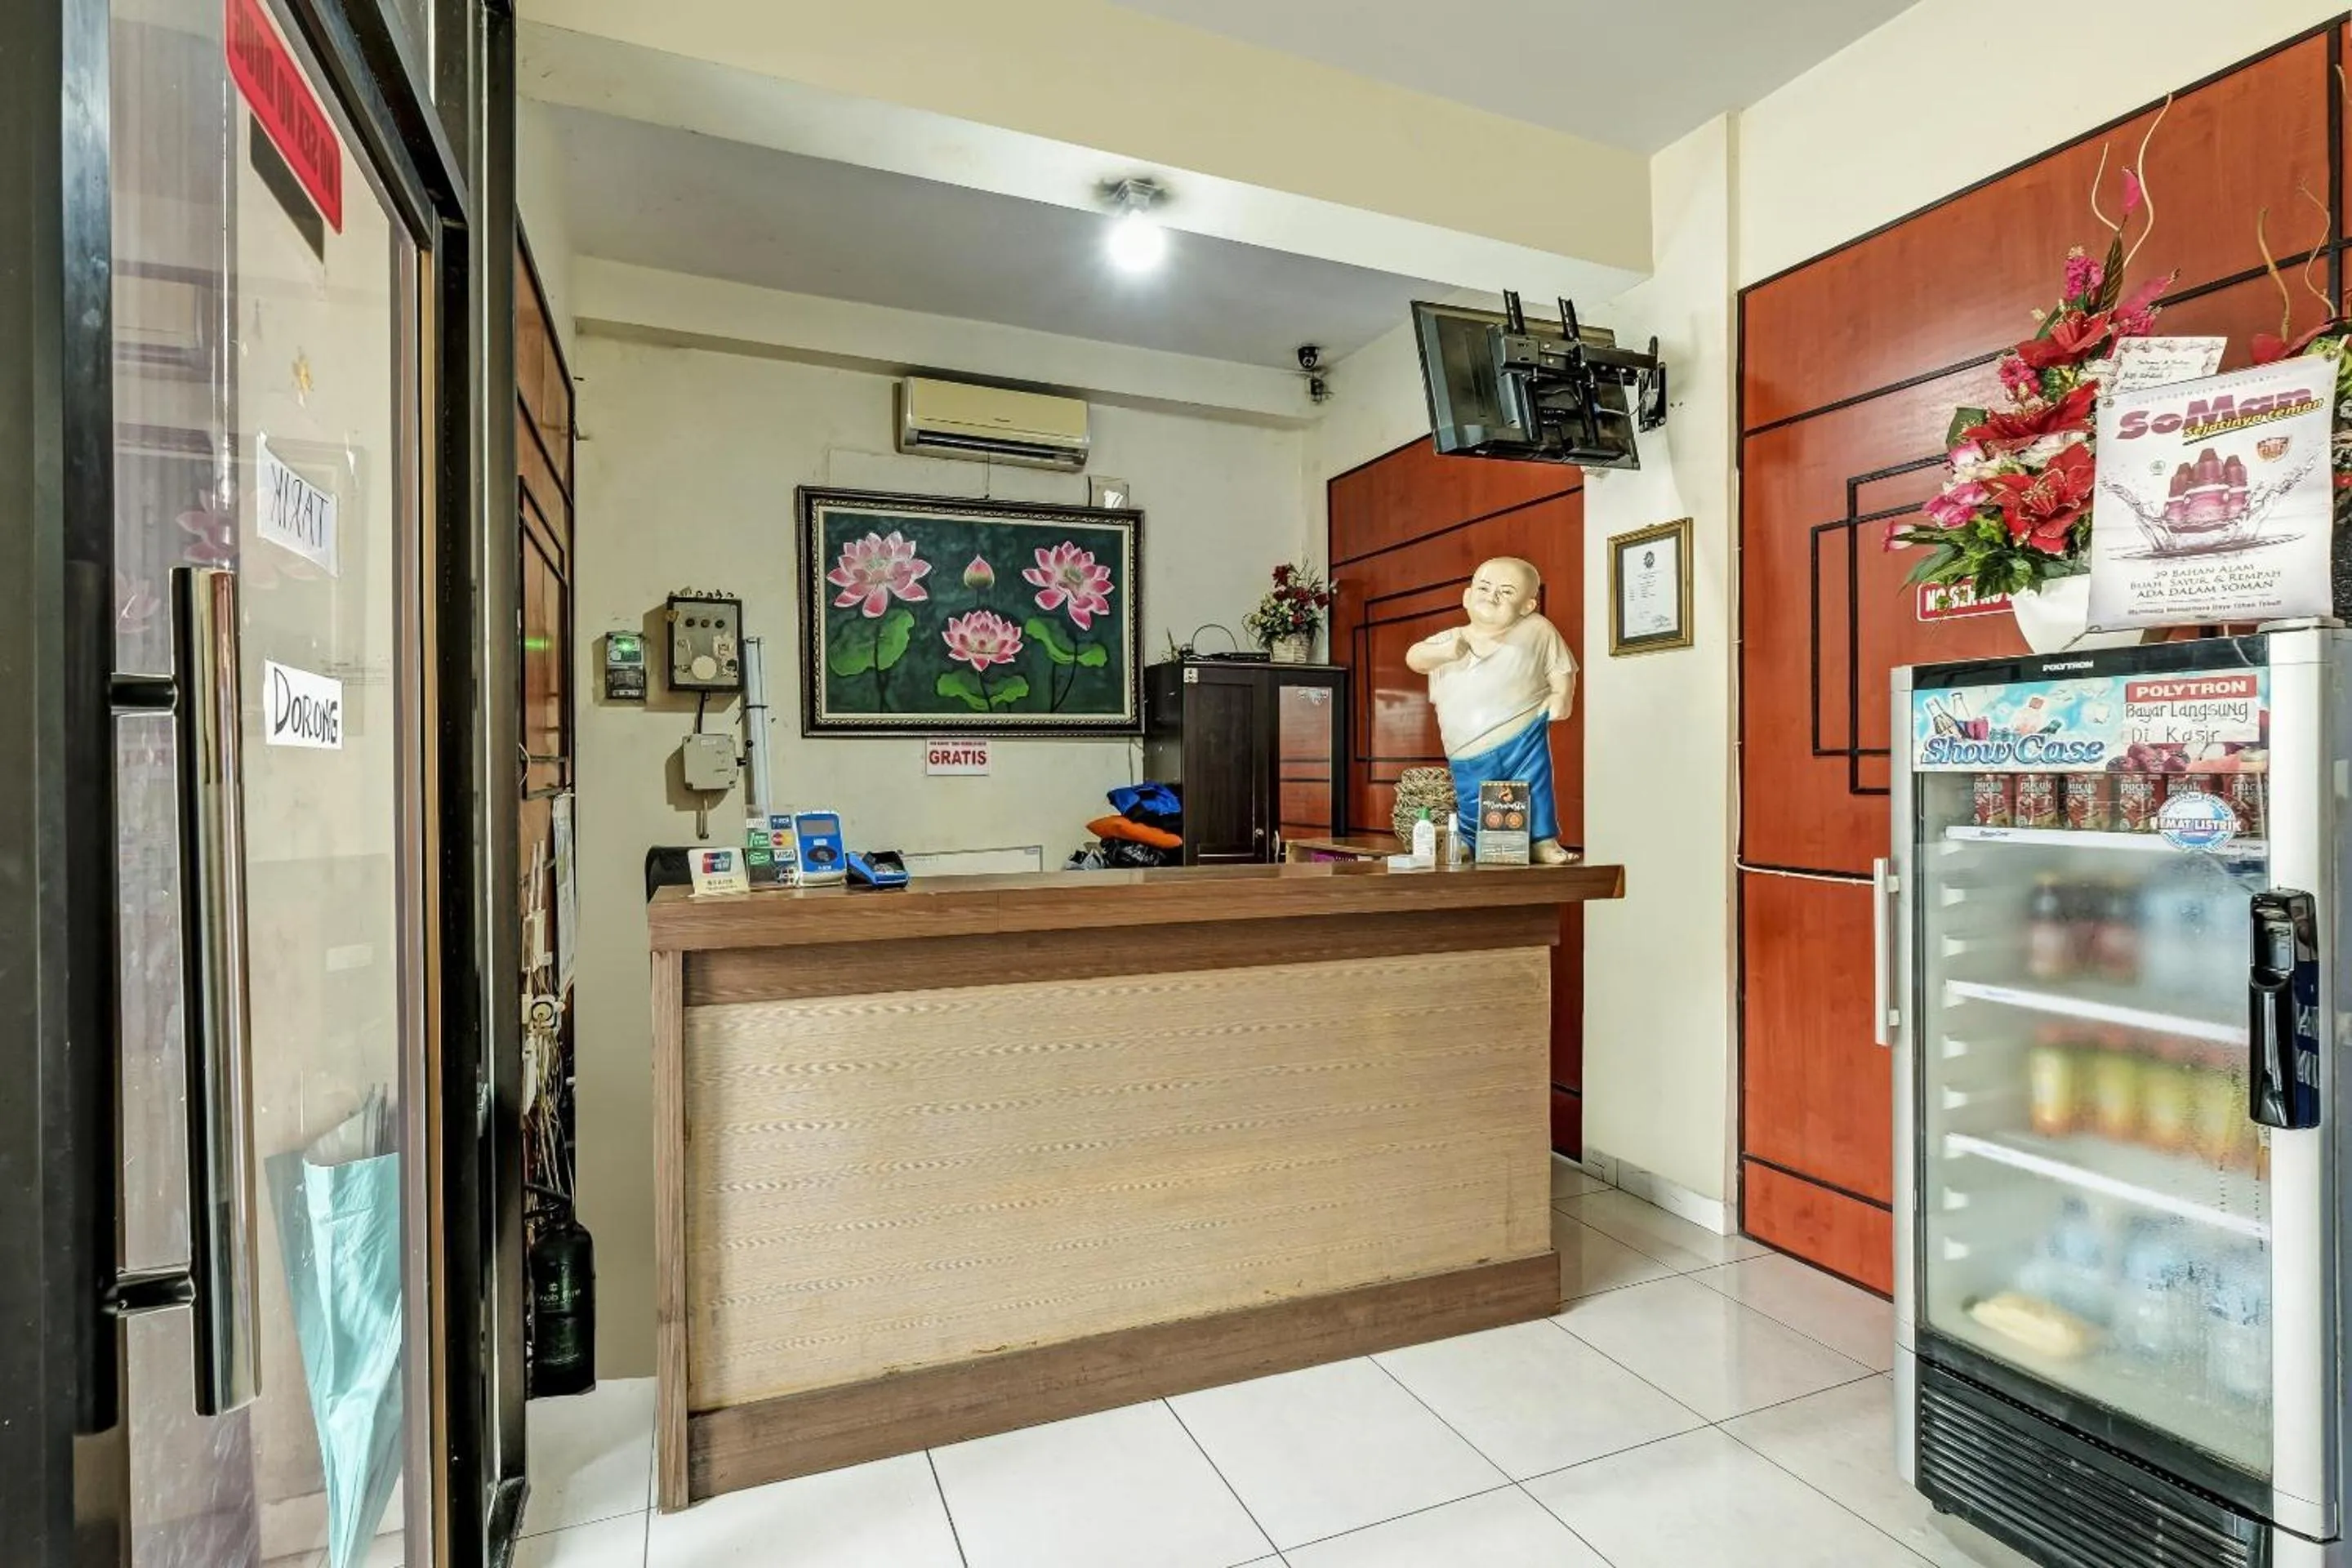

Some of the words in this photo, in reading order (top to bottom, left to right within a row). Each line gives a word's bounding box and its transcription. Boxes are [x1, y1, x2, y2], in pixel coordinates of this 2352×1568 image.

[2172, 567, 2215, 577] BAHAN
[2136, 589, 2164, 598] ADA
[2169, 585, 2216, 596] DALAM
[2221, 580, 2274, 591] SOMAN
[2042, 660, 2094, 672] POLYTRON
[2136, 680, 2247, 698] POLYTRON
[2126, 702, 2167, 723] Bayar
[2132, 728, 2149, 743] Di
[929, 750, 987, 765] GRATIS
